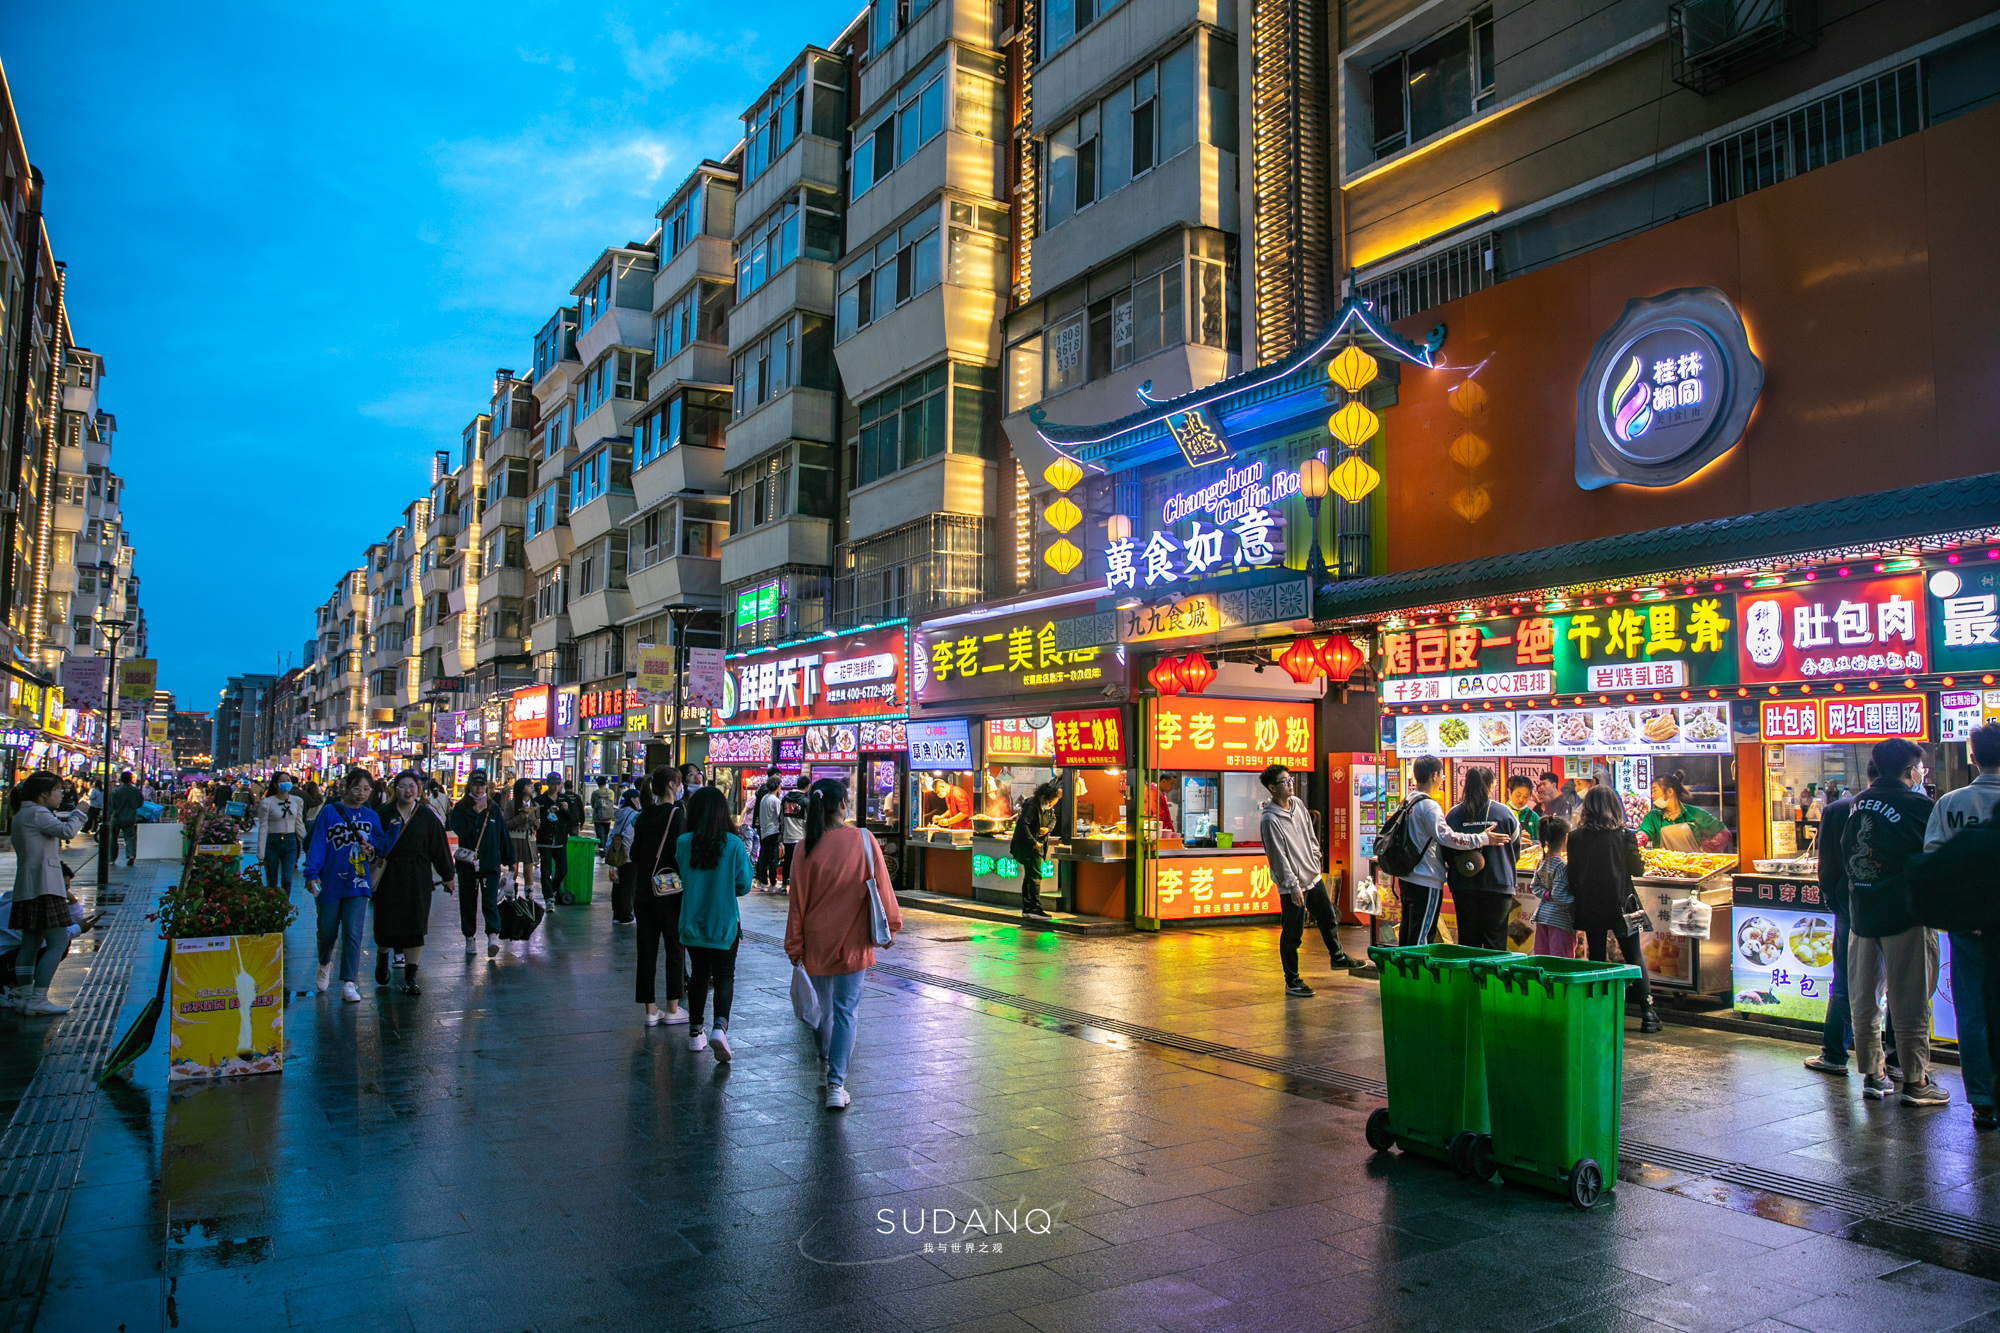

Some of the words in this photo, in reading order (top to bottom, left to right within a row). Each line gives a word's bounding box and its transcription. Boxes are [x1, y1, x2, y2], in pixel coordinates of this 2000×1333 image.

[1116, 305, 1132, 326] 女子
[1653, 351, 1702, 384] 桂林
[1653, 378, 1701, 411] 胡同
[1162, 461, 1263, 525] Changchun
[1104, 507, 1275, 590] 萬食如意
[1127, 600, 1208, 638] 九九食城
[1567, 597, 1732, 660] 干炸里脊
[1753, 607, 1772, 660] 科尔沁
[1793, 594, 1917, 650] 肚包肉
[1944, 594, 2000, 647] 最
[1384, 617, 1555, 676] 烤豆皮一绝
[739, 654, 823, 712] 鲜甲天下
[1394, 680, 1440, 701] 千多澜
[1486, 672, 1547, 694] QQ鸡排
[1596, 664, 1674, 688] 岩烧乳酪
[1055, 718, 1119, 752] 李老二炒粉
[1155, 711, 1310, 753] 李老二炒粉
[1766, 705, 1817, 737] 肚包肉
[1828, 702, 1922, 736] 网红圈圈肠
[1942, 718, 1954, 732] 10
[1771, 968, 1833, 999] 肚包
